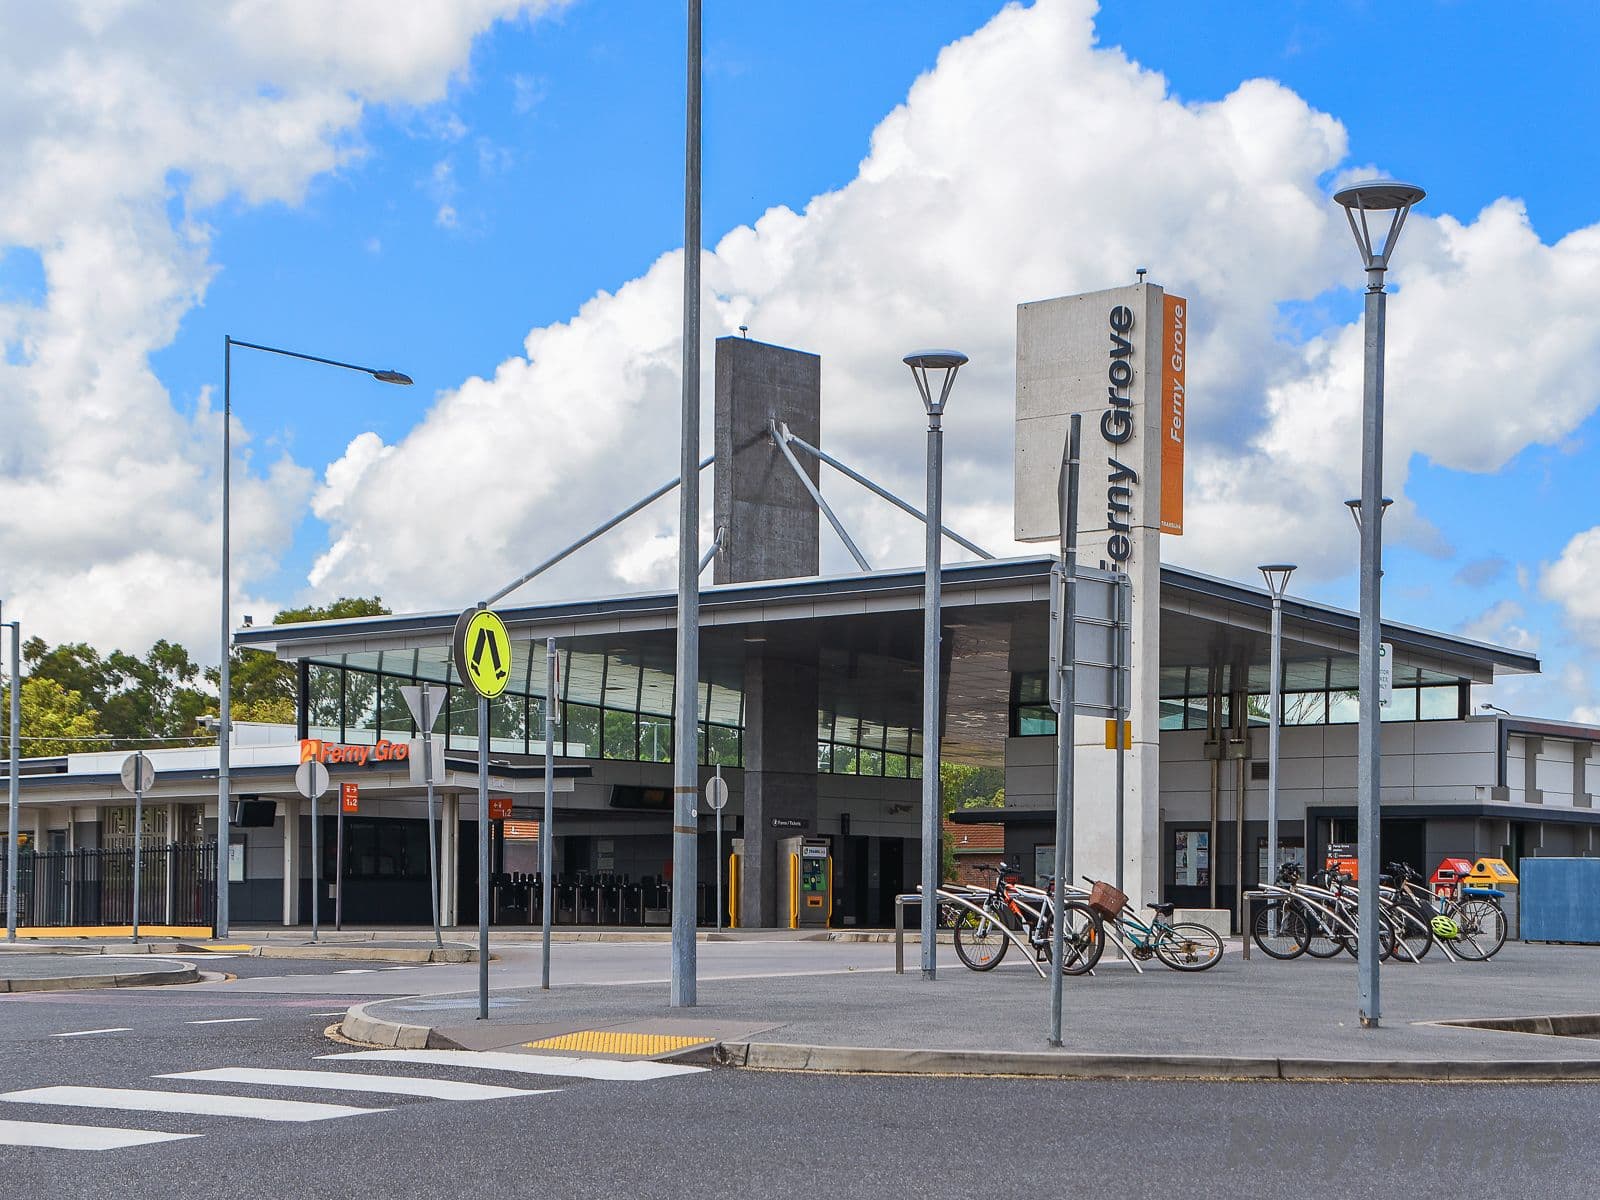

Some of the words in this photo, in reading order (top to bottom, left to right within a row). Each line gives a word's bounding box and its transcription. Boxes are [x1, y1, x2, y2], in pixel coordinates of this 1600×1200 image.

[1171, 304, 1184, 372] Grove
[1100, 305, 1133, 444] Grove
[1170, 378, 1184, 443] Ferny
[321, 742, 370, 766] Ferny
[374, 739, 410, 761] Gro
